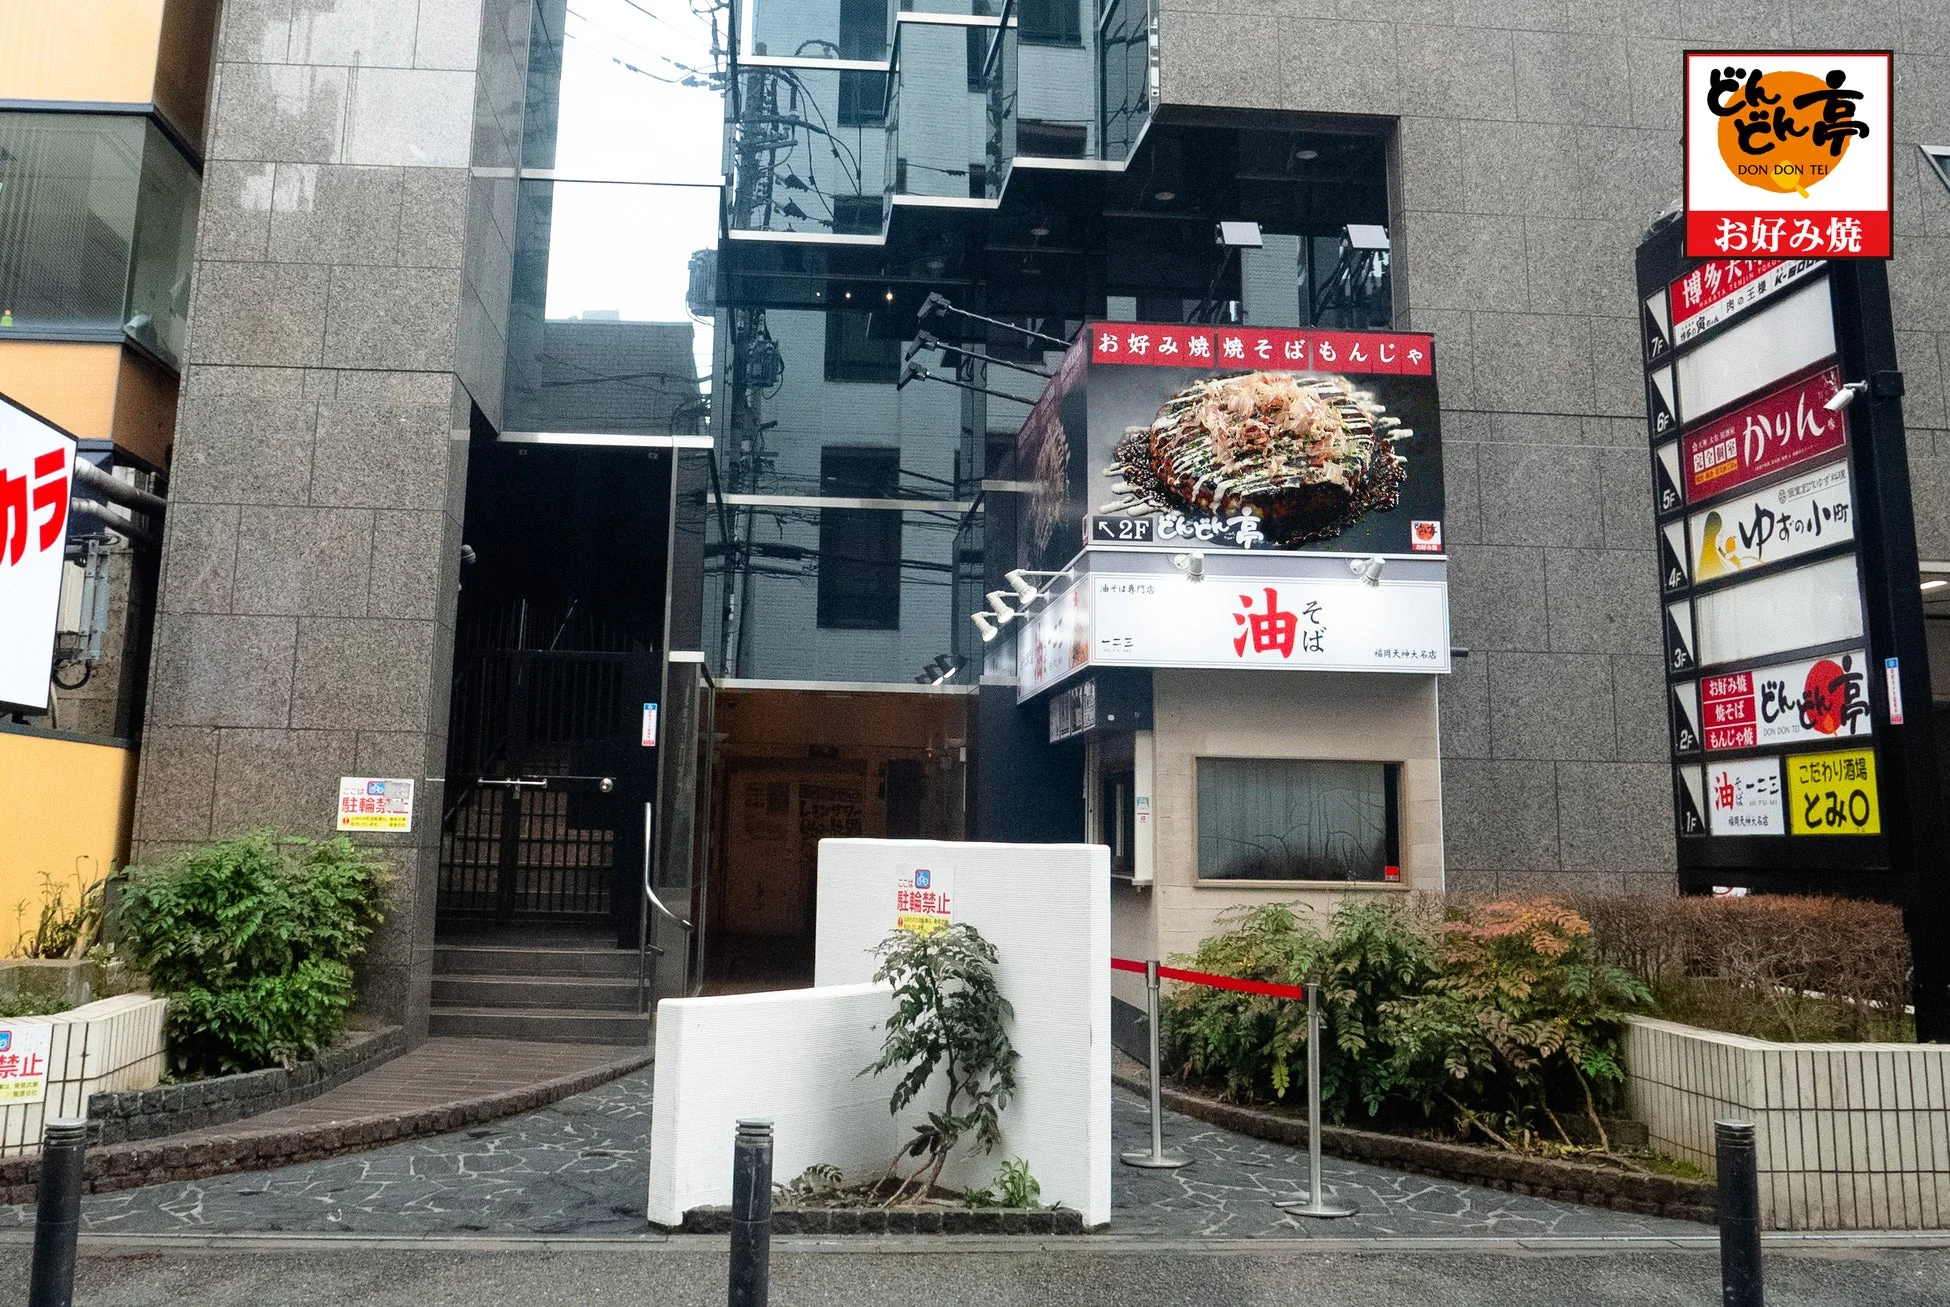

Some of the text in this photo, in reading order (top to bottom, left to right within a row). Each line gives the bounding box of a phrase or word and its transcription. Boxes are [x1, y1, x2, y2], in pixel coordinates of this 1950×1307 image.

[1098, 332, 1424, 365] お好み焼 焼そば もんじゃ
[1651, 338, 1664, 357] 7F
[1657, 412, 1670, 432] 6F
[1742, 391, 1825, 467] かりん
[1662, 489, 1676, 510] 5F
[1119, 520, 1150, 541] 2F
[1157, 506, 1265, 549] どんどん亭
[1738, 500, 1849, 559] ゆずの小町
[1668, 568, 1682, 588] 4F
[1100, 583, 1155, 595] 油そば専門店
[1232, 587, 1328, 659] 油 そば
[1101, 637, 1134, 648] 一二三
[1374, 648, 1437, 660] 福岡天神大名店
[1674, 648, 1687, 669] 3F
[1709, 674, 1748, 697] お好み焼
[1761, 655, 1871, 735] どんどん亭
[1715, 702, 1745, 722] 焼そば
[1680, 730, 1693, 750] 2F
[1710, 727, 1754, 749] もんじゃ焼
[1763, 724, 1800, 737] DON DON TEI
[1799, 757, 1868, 784] こだわり酒場
[1715, 771, 1736, 811] 油
[1746, 775, 1780, 795] 一二三
[1686, 811, 1697, 833] 1F
[898, 878, 914, 888] ここは
[897, 890, 951, 915] 駐輪禁止
